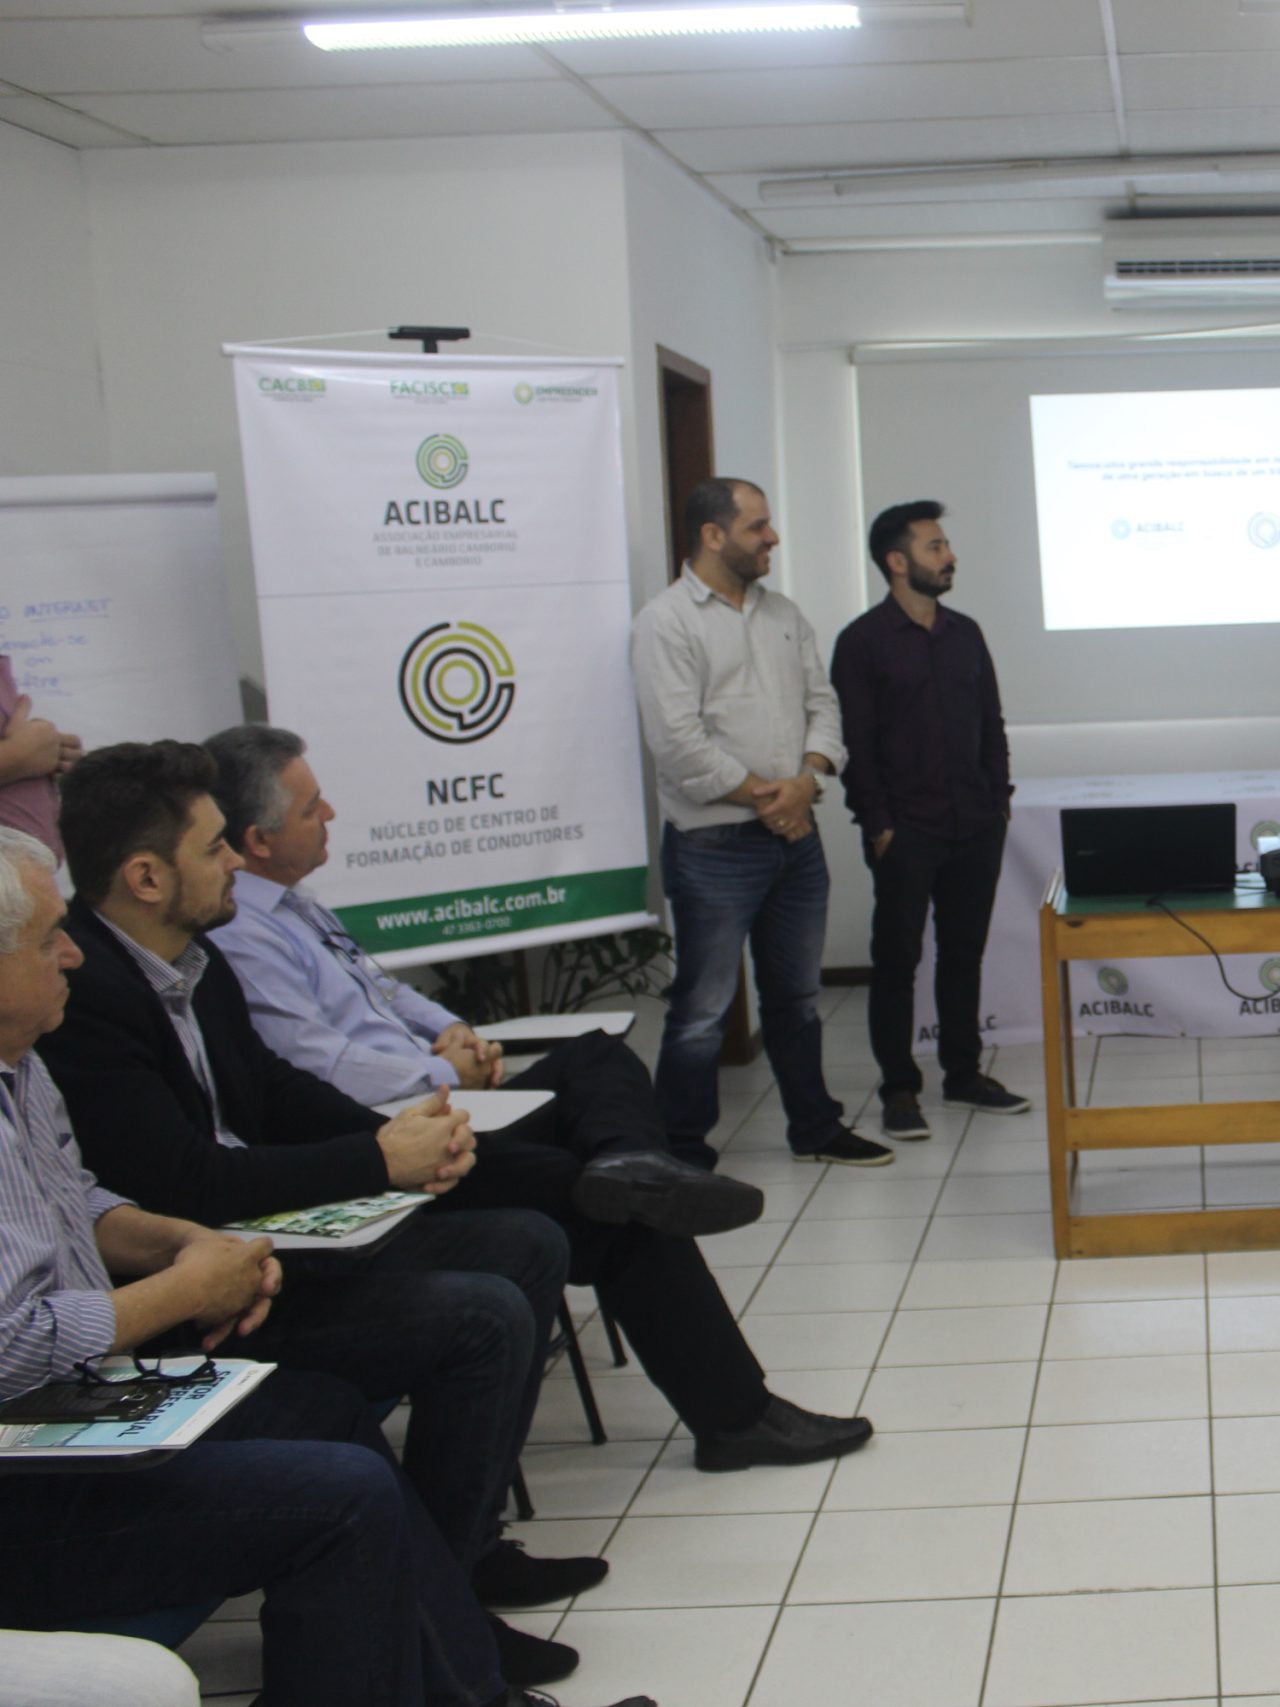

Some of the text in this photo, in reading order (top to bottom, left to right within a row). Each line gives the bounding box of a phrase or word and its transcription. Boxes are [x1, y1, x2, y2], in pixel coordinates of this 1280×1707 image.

[383, 498, 507, 527] ACIBALC
[1136, 520, 1185, 533] ACIBALC
[425, 773, 505, 806] NCFC
[369, 805, 560, 843] NÚCLEO DE CENTRO DE
[345, 823, 585, 869] FORMAÇÃO DE CONDUTORES
[376, 885, 568, 931] www.acibalc.com.br
[1079, 1000, 1155, 1018] ACIBALC
